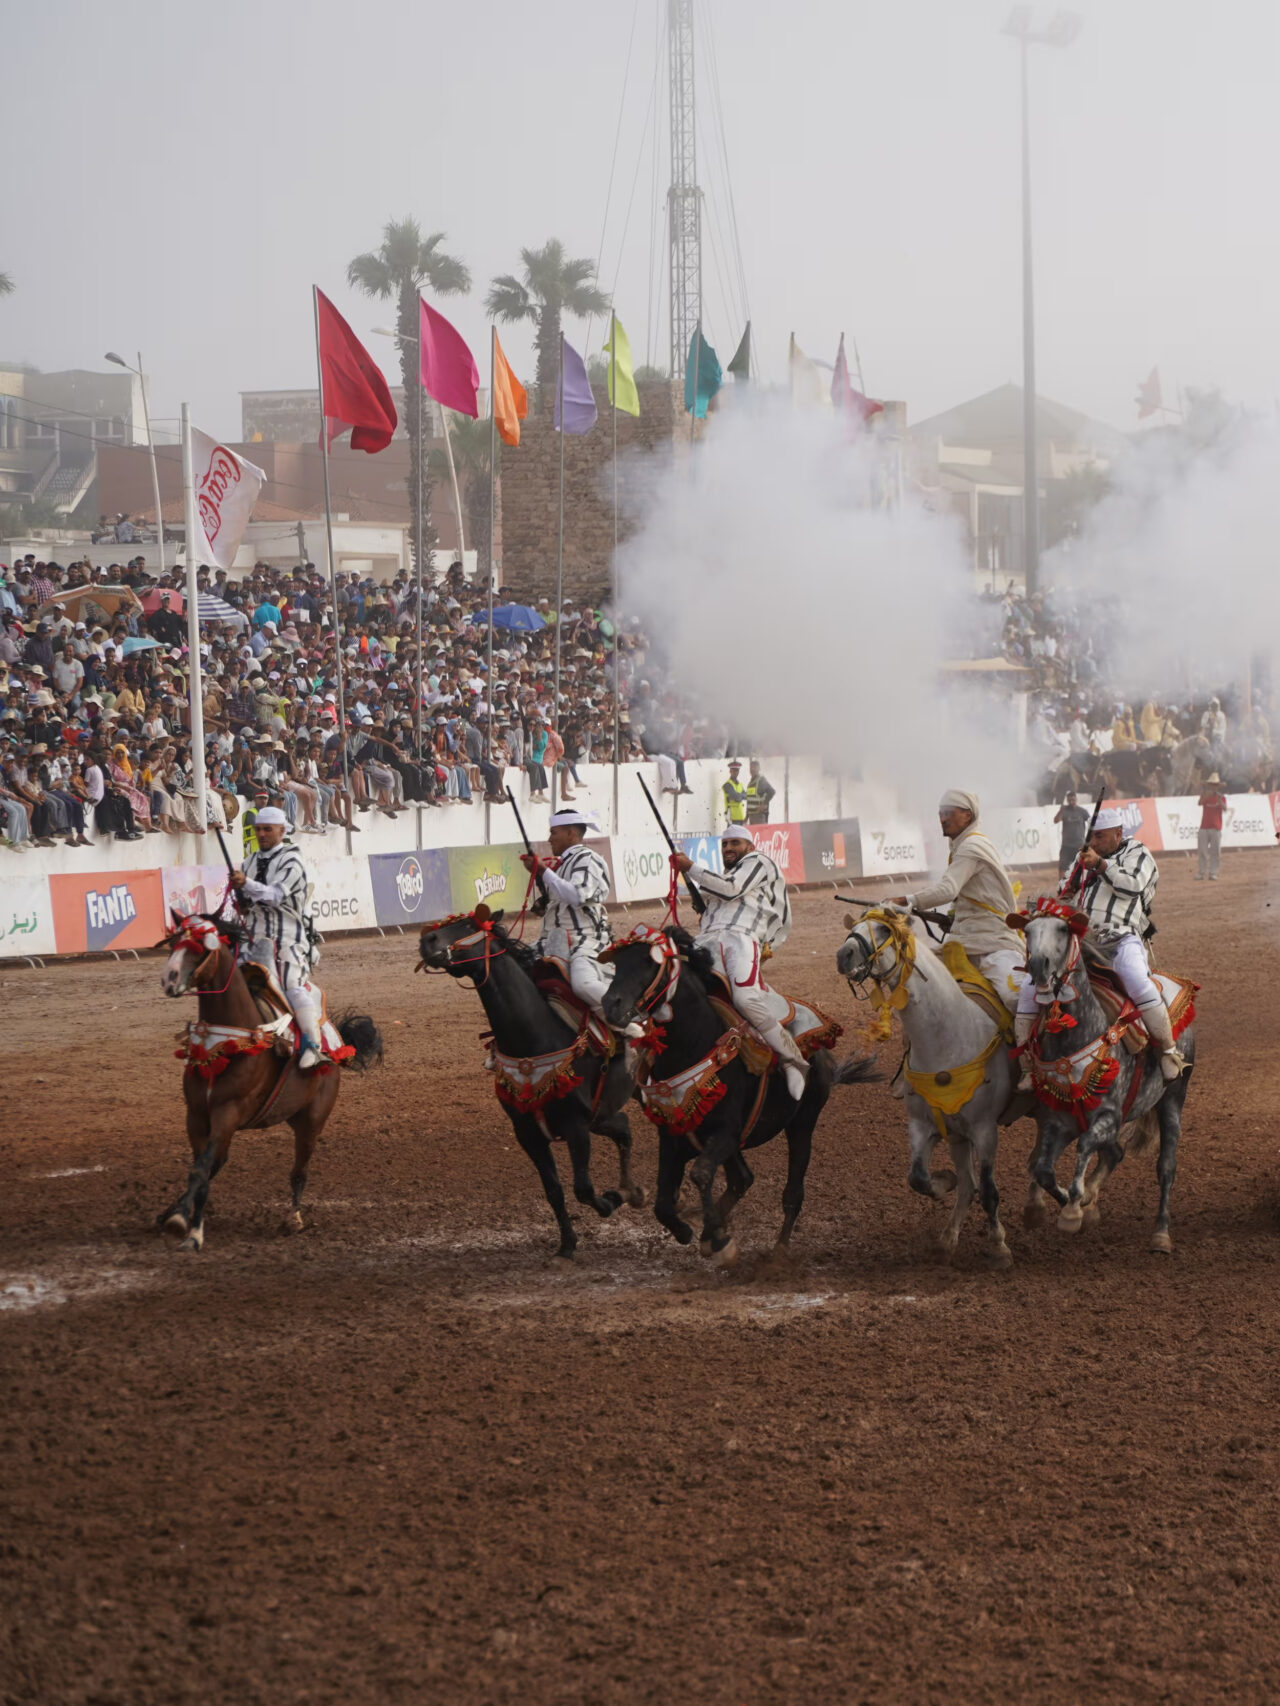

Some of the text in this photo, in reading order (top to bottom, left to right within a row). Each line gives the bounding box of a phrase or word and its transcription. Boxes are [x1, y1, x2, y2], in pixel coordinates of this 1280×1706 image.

[199, 446, 241, 552] Coca-C
[1179, 826, 1199, 840] SORE
[1232, 820, 1264, 832] SOREC
[1015, 829, 1040, 849] OCP
[883, 845, 915, 861] SOREC
[639, 852, 664, 877] OCP
[86, 885, 136, 929] FANTA
[311, 898, 359, 918] SOREC
